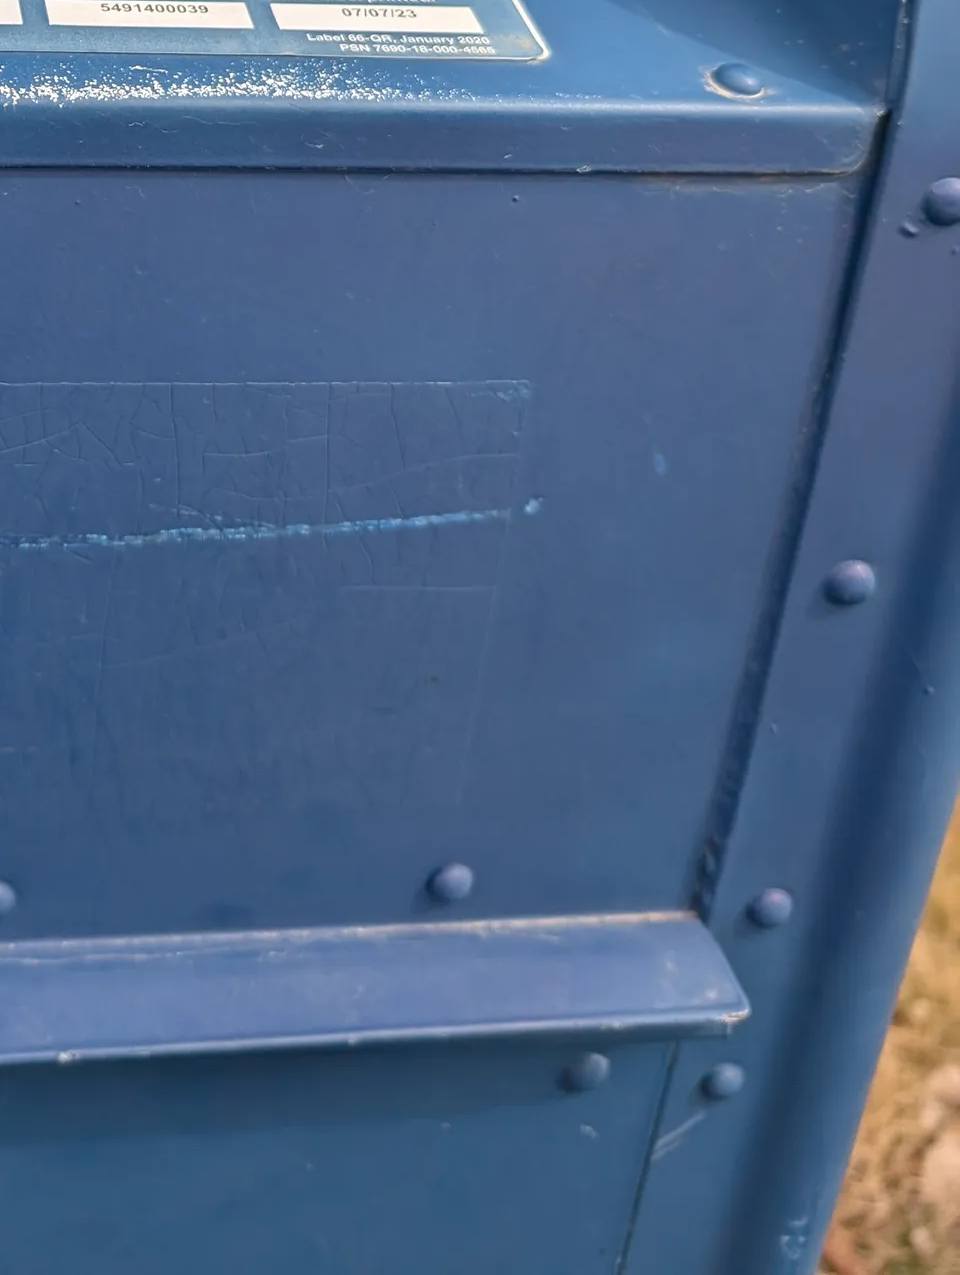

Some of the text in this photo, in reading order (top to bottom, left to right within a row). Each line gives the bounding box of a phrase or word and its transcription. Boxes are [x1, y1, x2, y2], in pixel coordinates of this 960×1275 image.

[100, 3, 209, 14] 5491400039
[307, 32, 491, 46] Label 66-QR, January 2020
[340, 43, 370, 53] PSN
